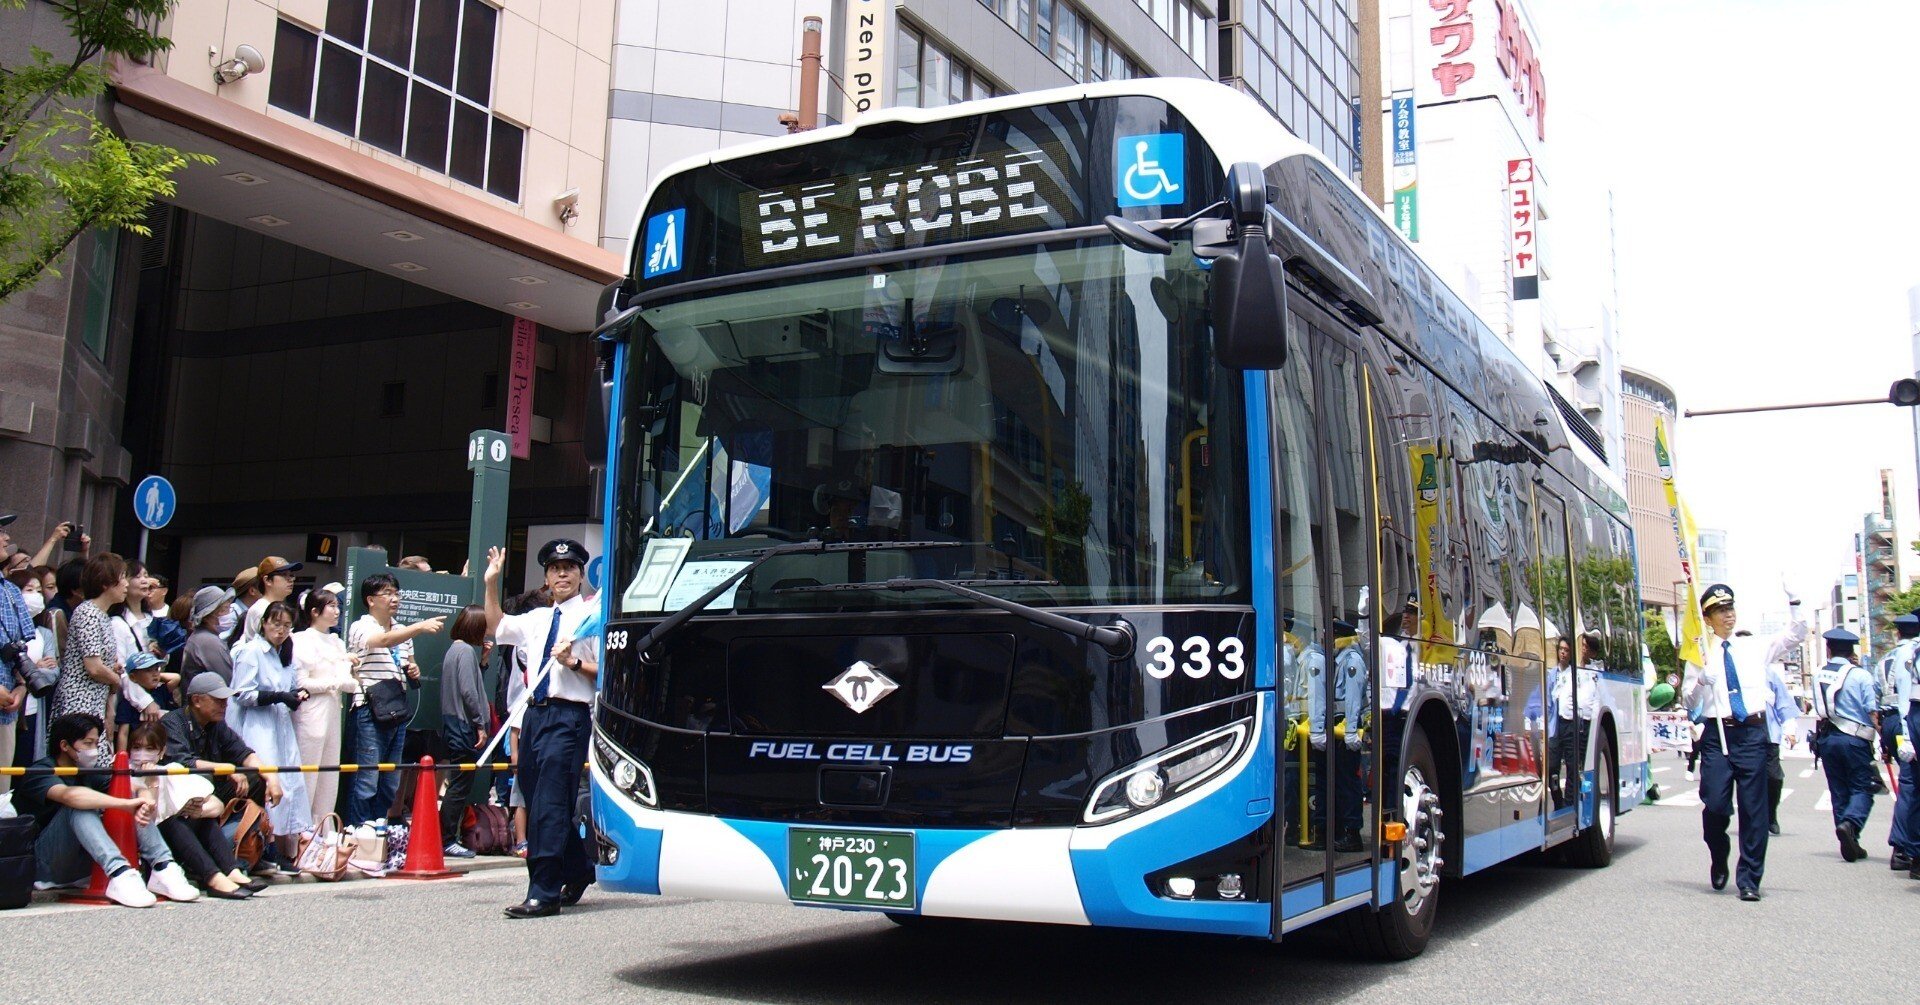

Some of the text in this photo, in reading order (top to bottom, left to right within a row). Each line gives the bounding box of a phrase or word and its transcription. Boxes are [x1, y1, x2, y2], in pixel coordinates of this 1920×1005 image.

[854, 13, 875, 113] zen pla
[759, 150, 1049, 253] BE KOBE
[1366, 219, 1434, 311] FUEL
[606, 630, 628, 650] 333
[1145, 635, 1245, 680] 333
[1469, 650, 1487, 686] 333
[750, 742, 973, 763] FUEL CELL BUS
[795, 854, 908, 900] い 20-23
